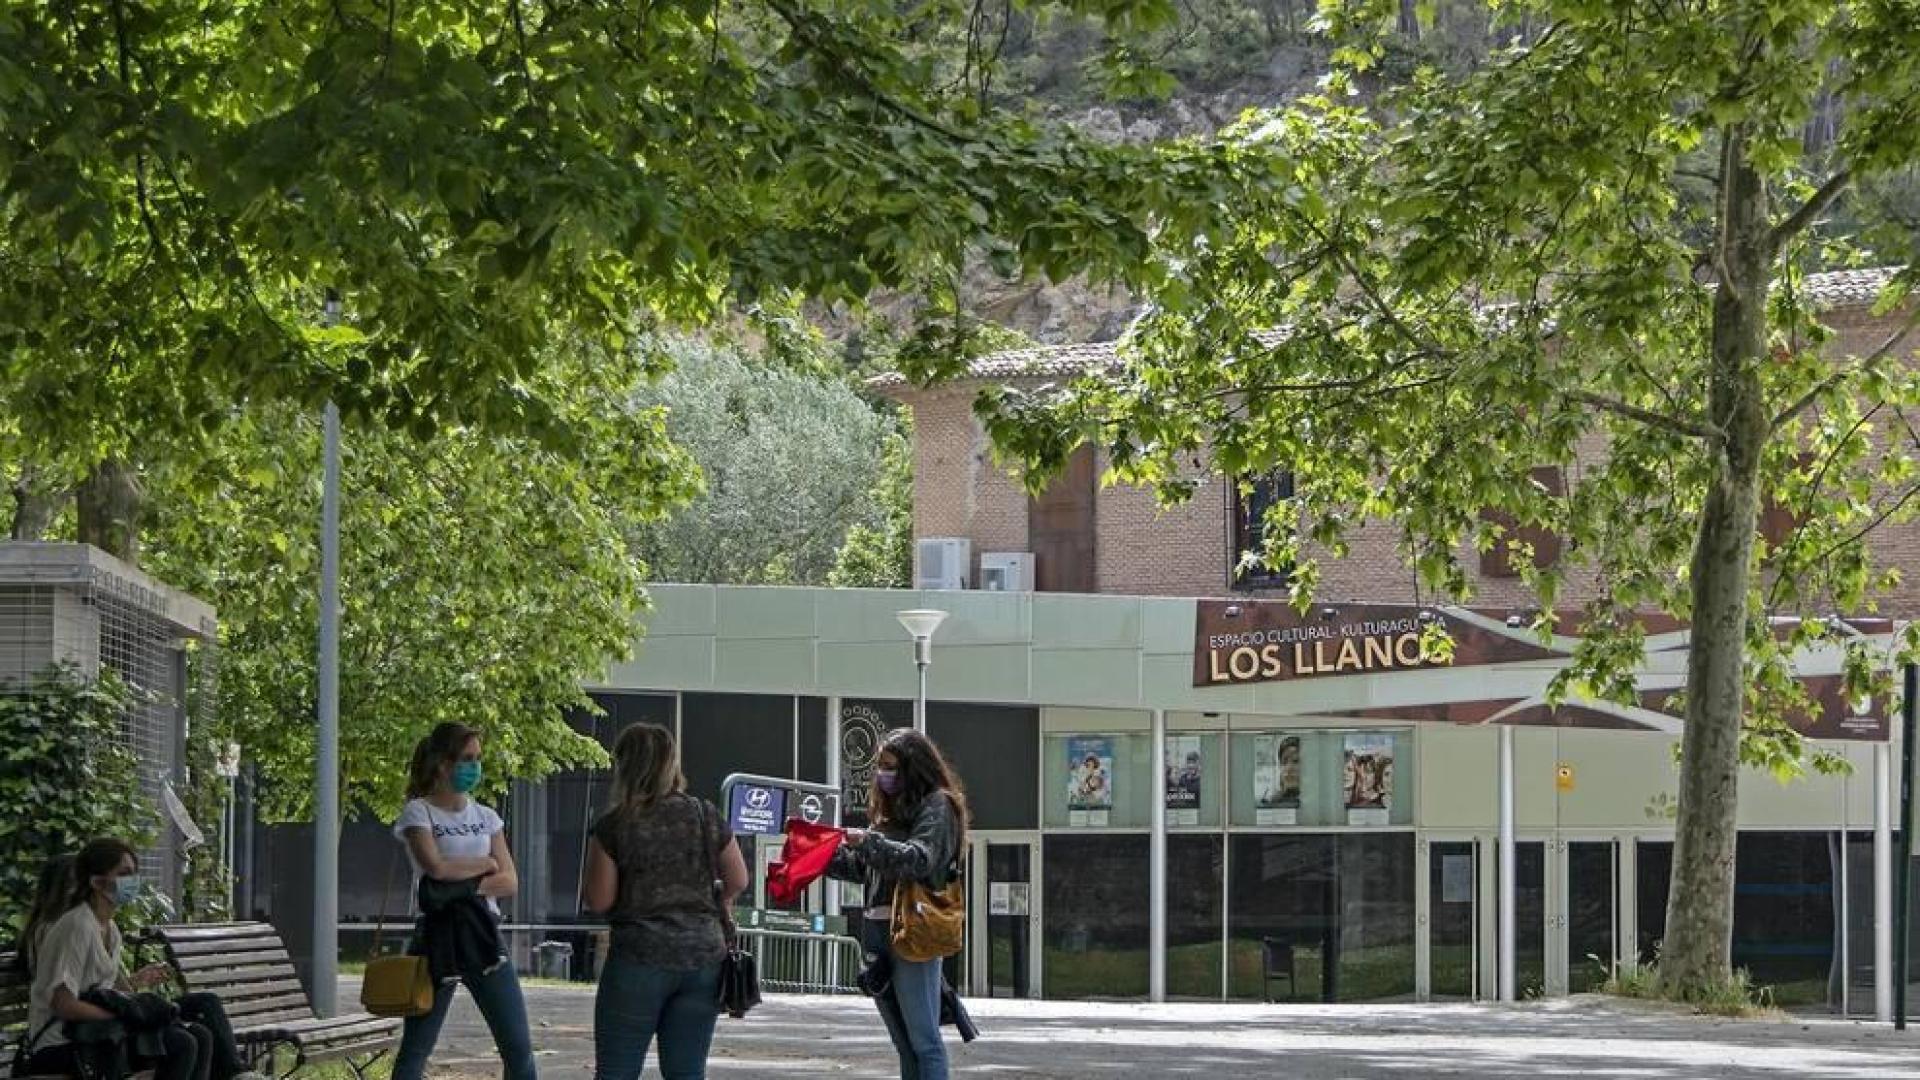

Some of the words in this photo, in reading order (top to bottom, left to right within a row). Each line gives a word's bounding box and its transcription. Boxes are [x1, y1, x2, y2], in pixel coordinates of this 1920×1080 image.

[1209, 631, 1265, 649] ESPACIO
[1340, 615, 1446, 637] KULTURAGUA
[1211, 643, 1281, 681] LOS
[1295, 633, 1446, 674] LLANO
